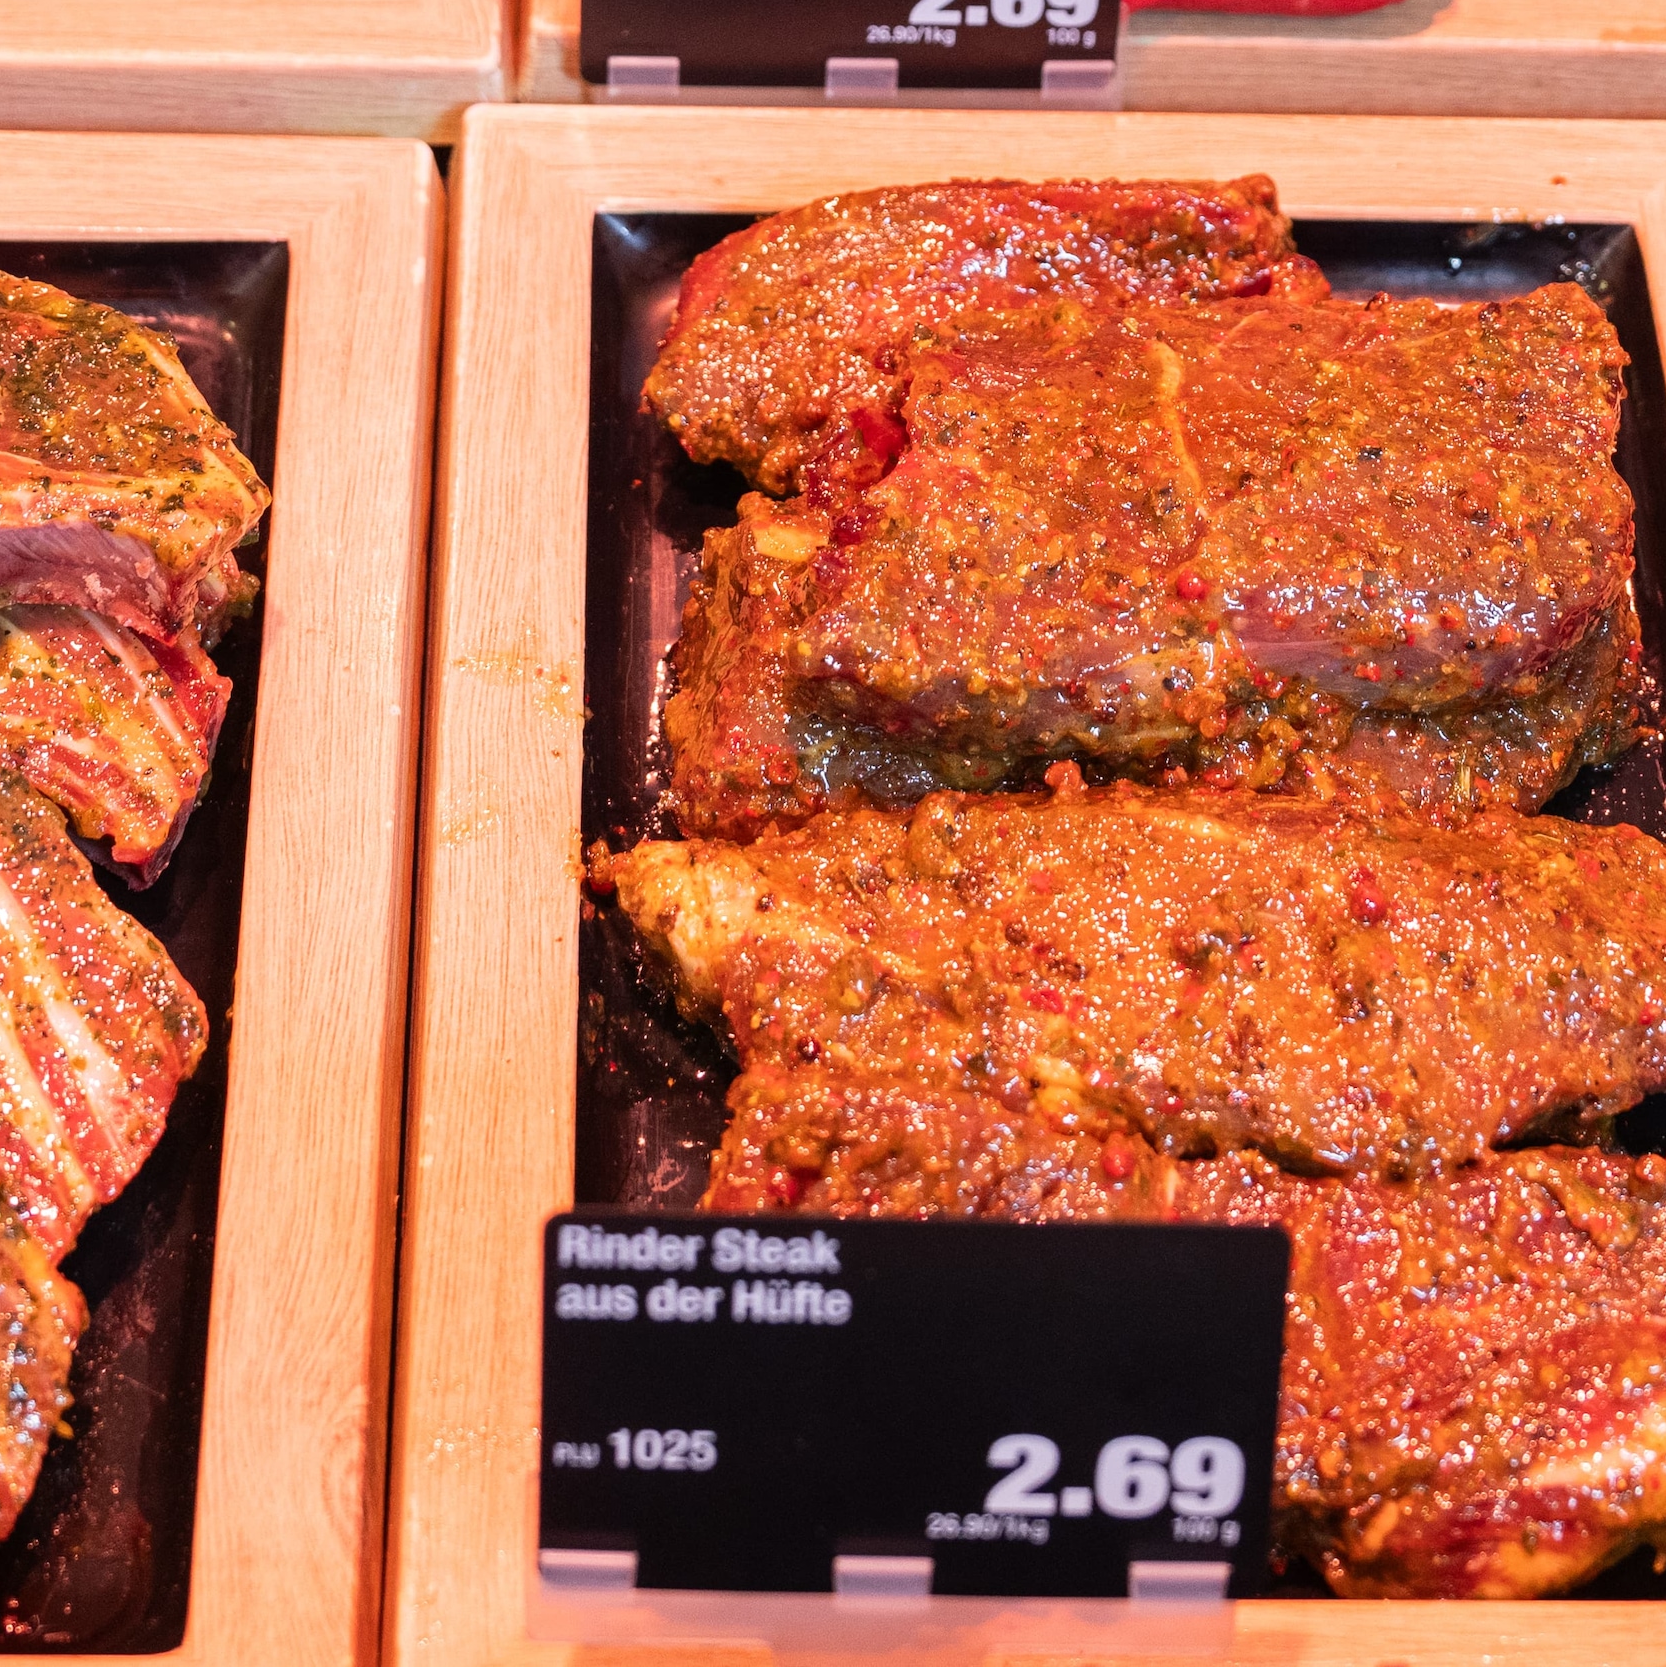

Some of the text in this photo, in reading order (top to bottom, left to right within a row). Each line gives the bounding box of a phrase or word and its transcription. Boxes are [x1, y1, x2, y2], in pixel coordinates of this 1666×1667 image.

[866, 25, 956, 48] 26.90/1kg
[1046, 28, 1097, 49] 100 g
[557, 1224, 840, 1274] Rinder Steak
[556, 1279, 853, 1325] aus der Hüfte
[553, 1429, 718, 1471] PLU 1025
[984, 1433, 1246, 1518] 2.69
[926, 1513, 1050, 1545] 26.90/1kg
[1173, 1517, 1240, 1546] 100 g
